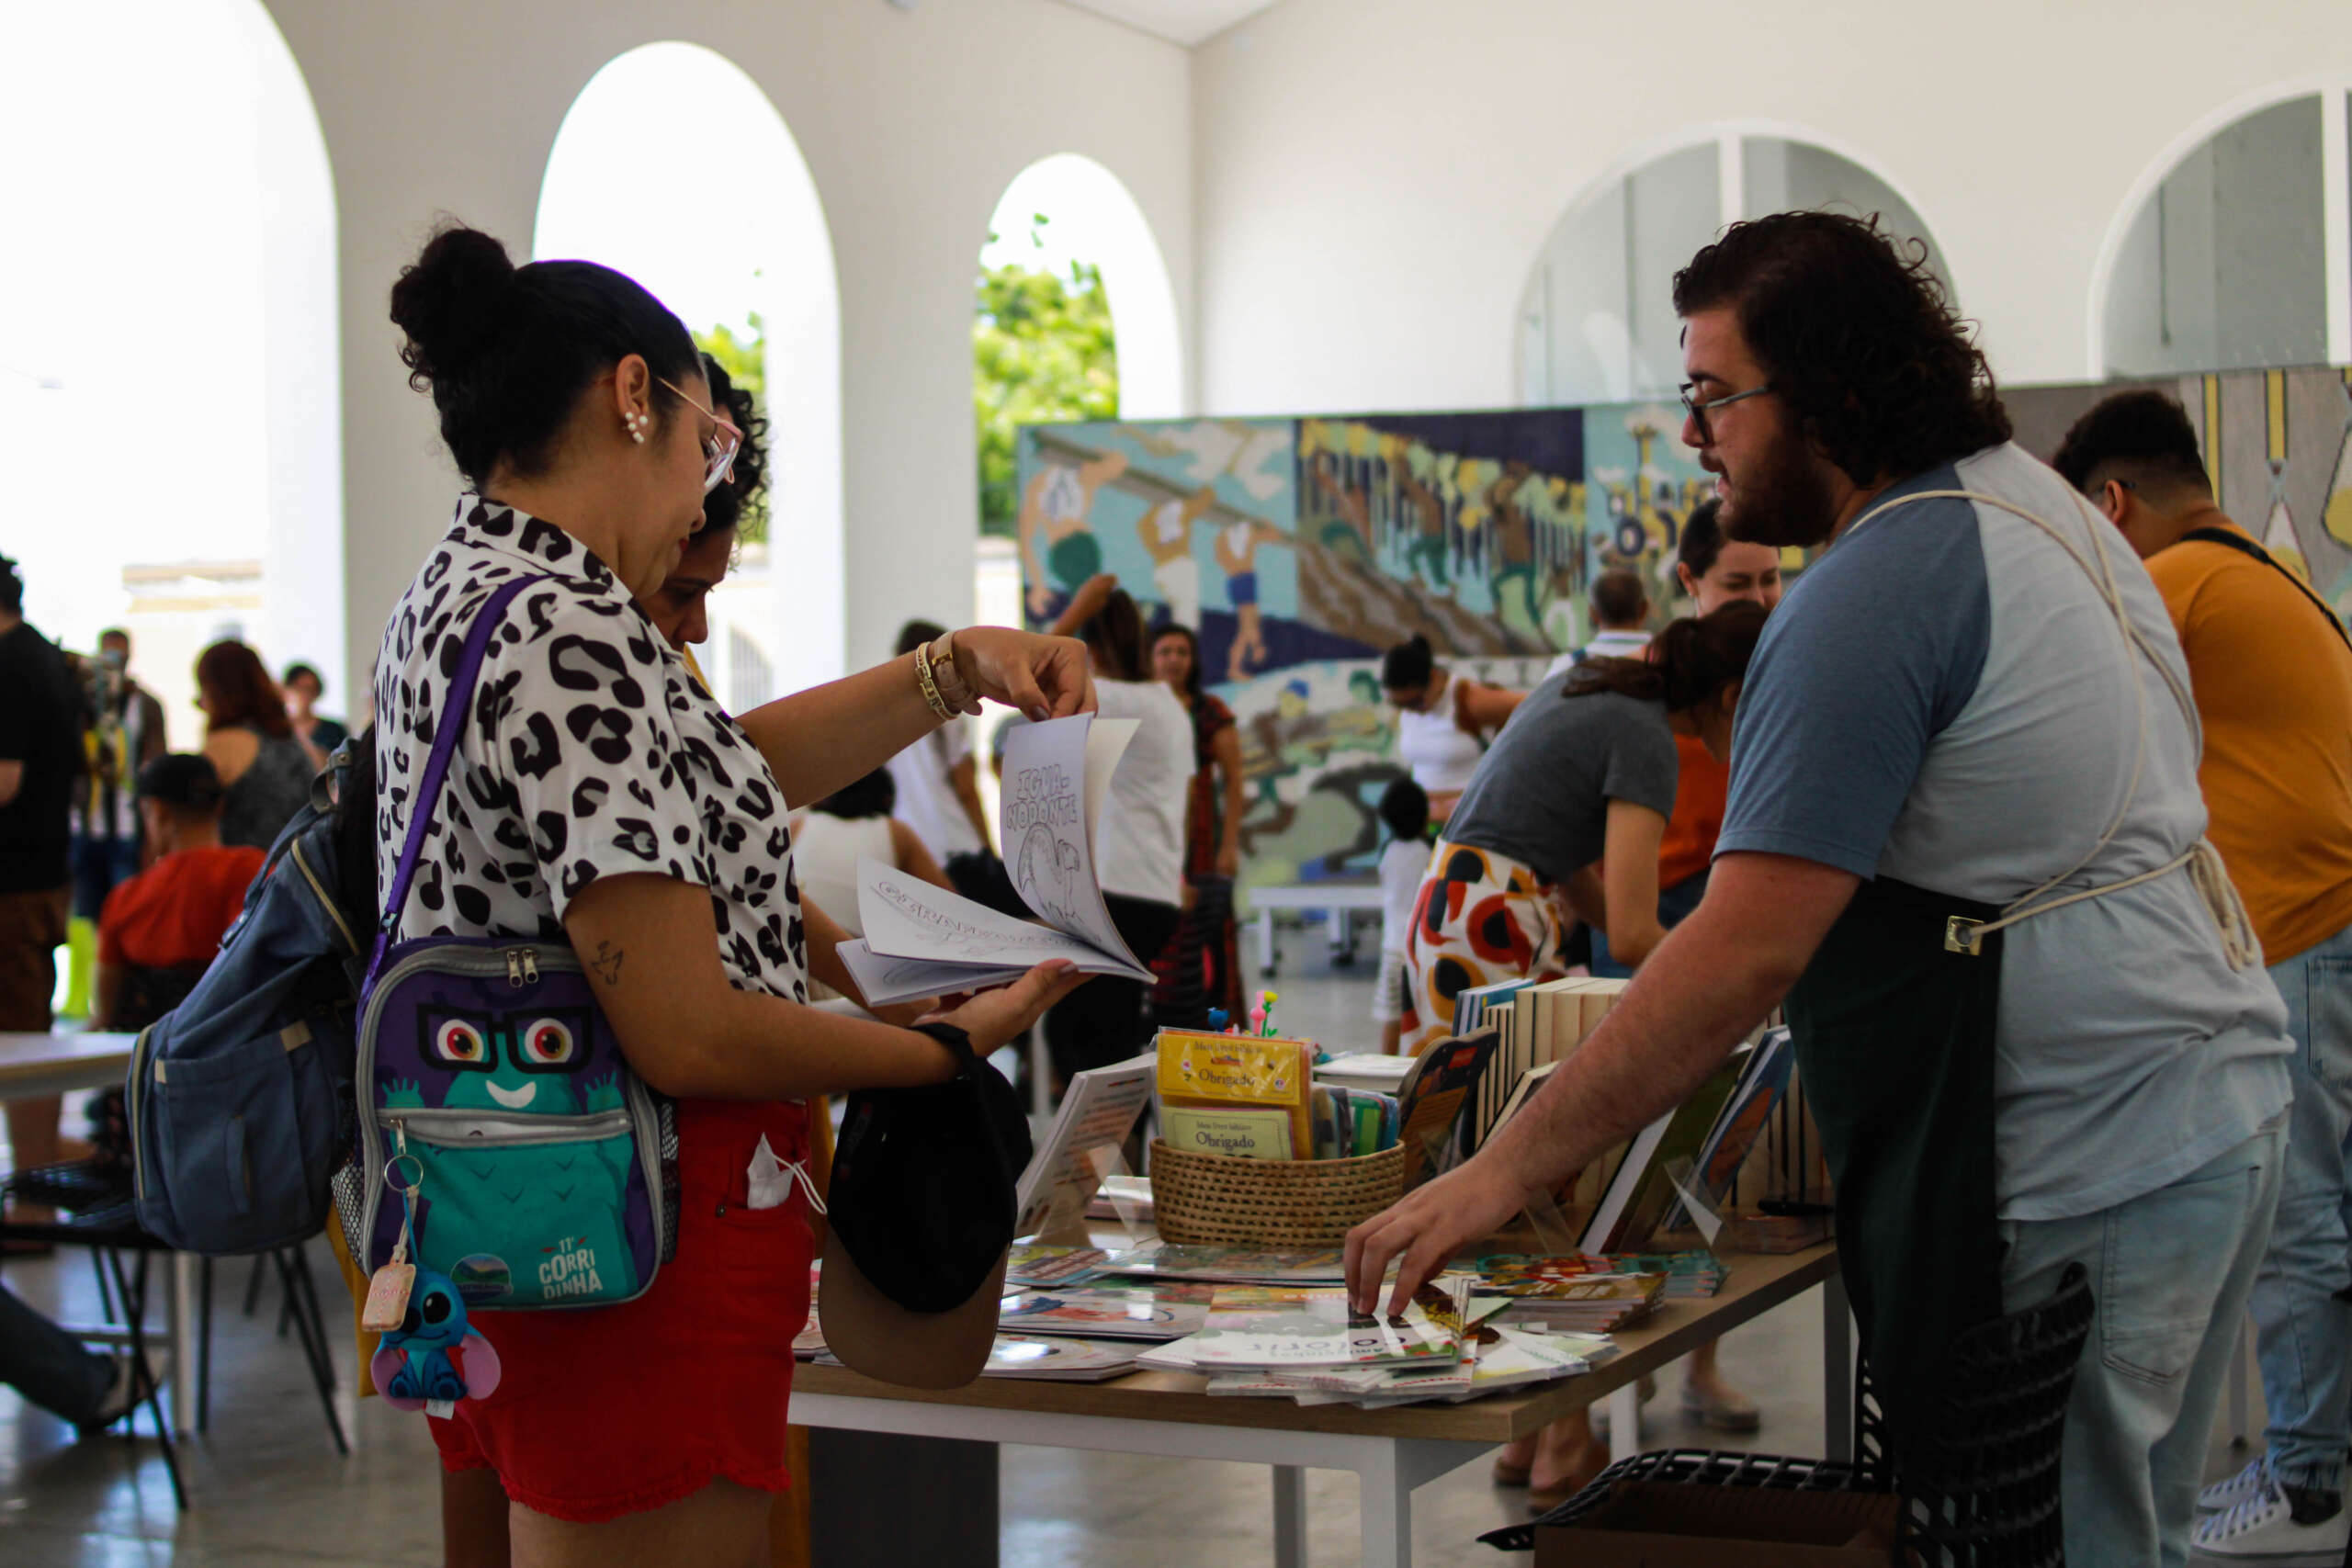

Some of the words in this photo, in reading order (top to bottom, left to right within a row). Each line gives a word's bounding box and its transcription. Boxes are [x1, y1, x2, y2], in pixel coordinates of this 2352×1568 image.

[1199, 1068, 1255, 1089] Obrigado
[1196, 1132, 1255, 1151] Obrigado
[538, 1248, 596, 1284] CORRI
[543, 1268, 604, 1300] DINHA
